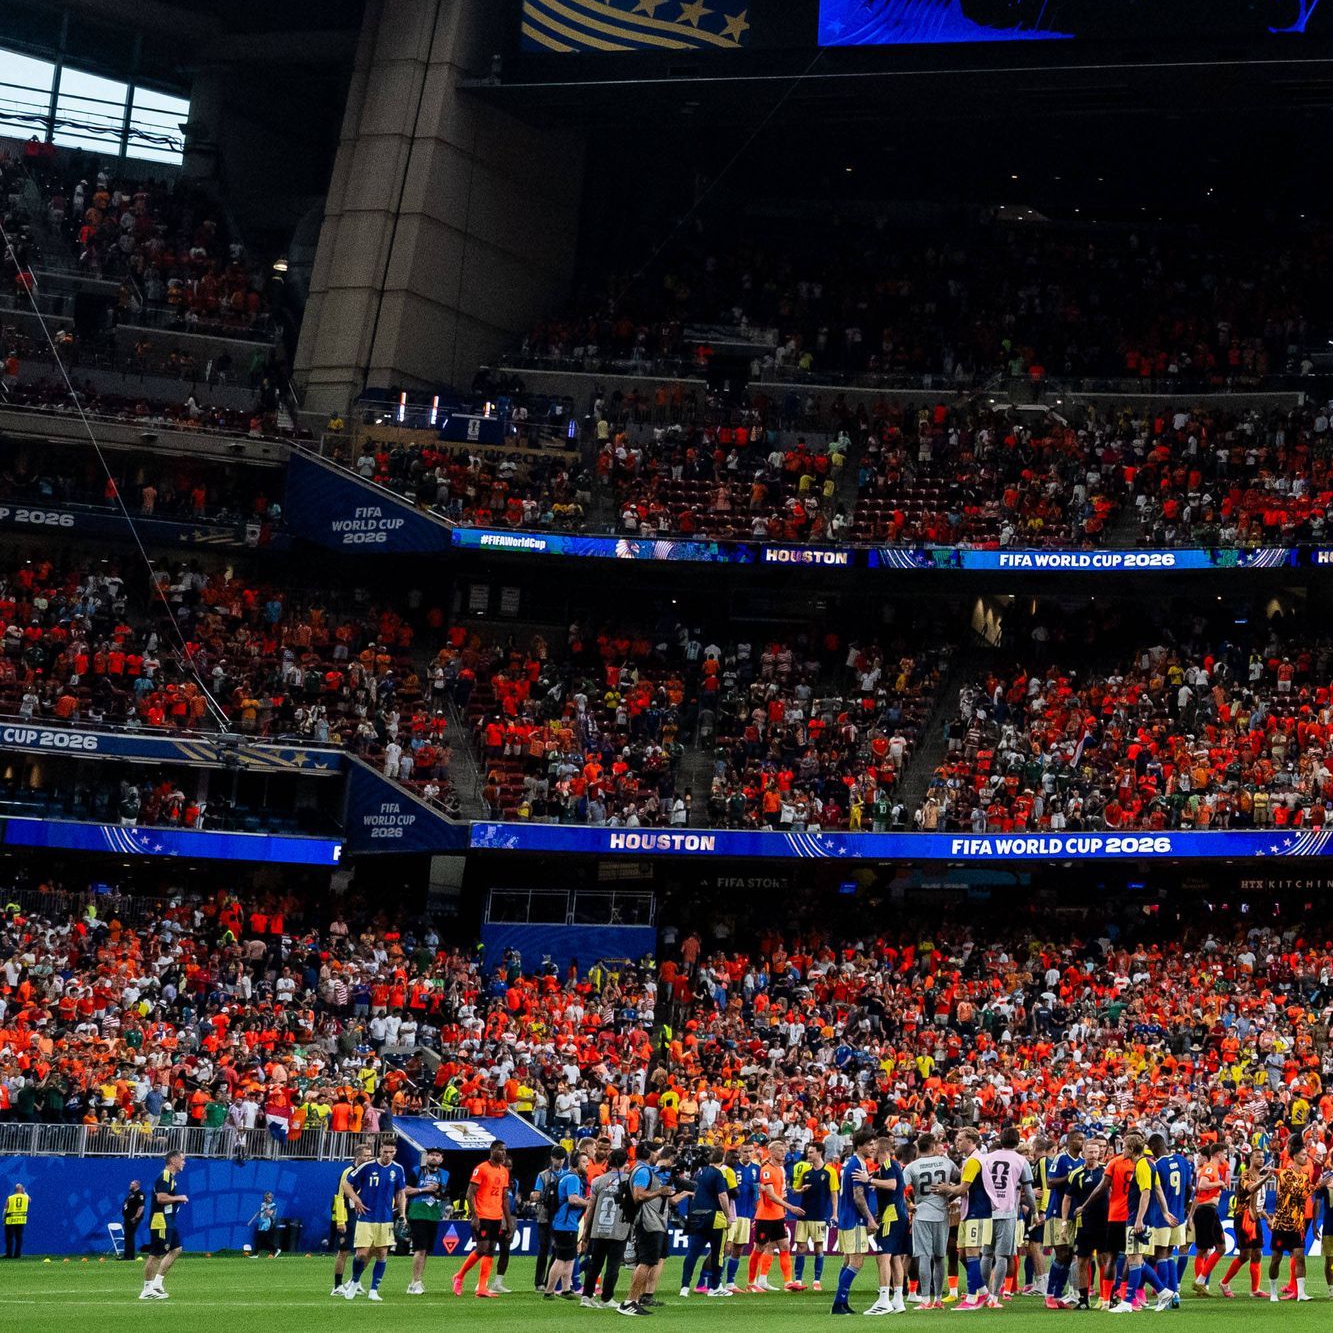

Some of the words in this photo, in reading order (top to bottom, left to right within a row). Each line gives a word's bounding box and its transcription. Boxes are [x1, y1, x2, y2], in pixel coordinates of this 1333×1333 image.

[15, 508, 75, 527] 2026
[354, 507, 382, 519] FIFA
[331, 518, 378, 532] WORLD
[379, 518, 405, 530] CUP
[342, 531, 388, 544] 2026
[481, 535, 545, 550] #FIFAWorldCup
[766, 549, 847, 564] HOUSTON
[1000, 555, 1032, 566] FIFA
[1035, 555, 1090, 566] WORLD
[1093, 555, 1121, 566] CUP
[1124, 554, 1174, 566] 2026
[4, 729, 37, 745] CUP
[39, 731, 98, 750] 2026
[380, 803, 400, 813] FIFA
[363, 815, 396, 826] WORLD
[397, 815, 416, 825] CUP
[371, 827, 403, 838] 2026
[611, 834, 715, 850] HOUSTON
[952, 840, 992, 854] FIFA
[996, 839, 1062, 854] WORLD
[1066, 839, 1102, 853] CUP
[1106, 838, 1170, 852] 2026
[717, 877, 744, 888] FIFA
[369, 1176, 380, 1187] 17
[1169, 1171, 1181, 1196] 9
[970, 1227, 977, 1238] 6
